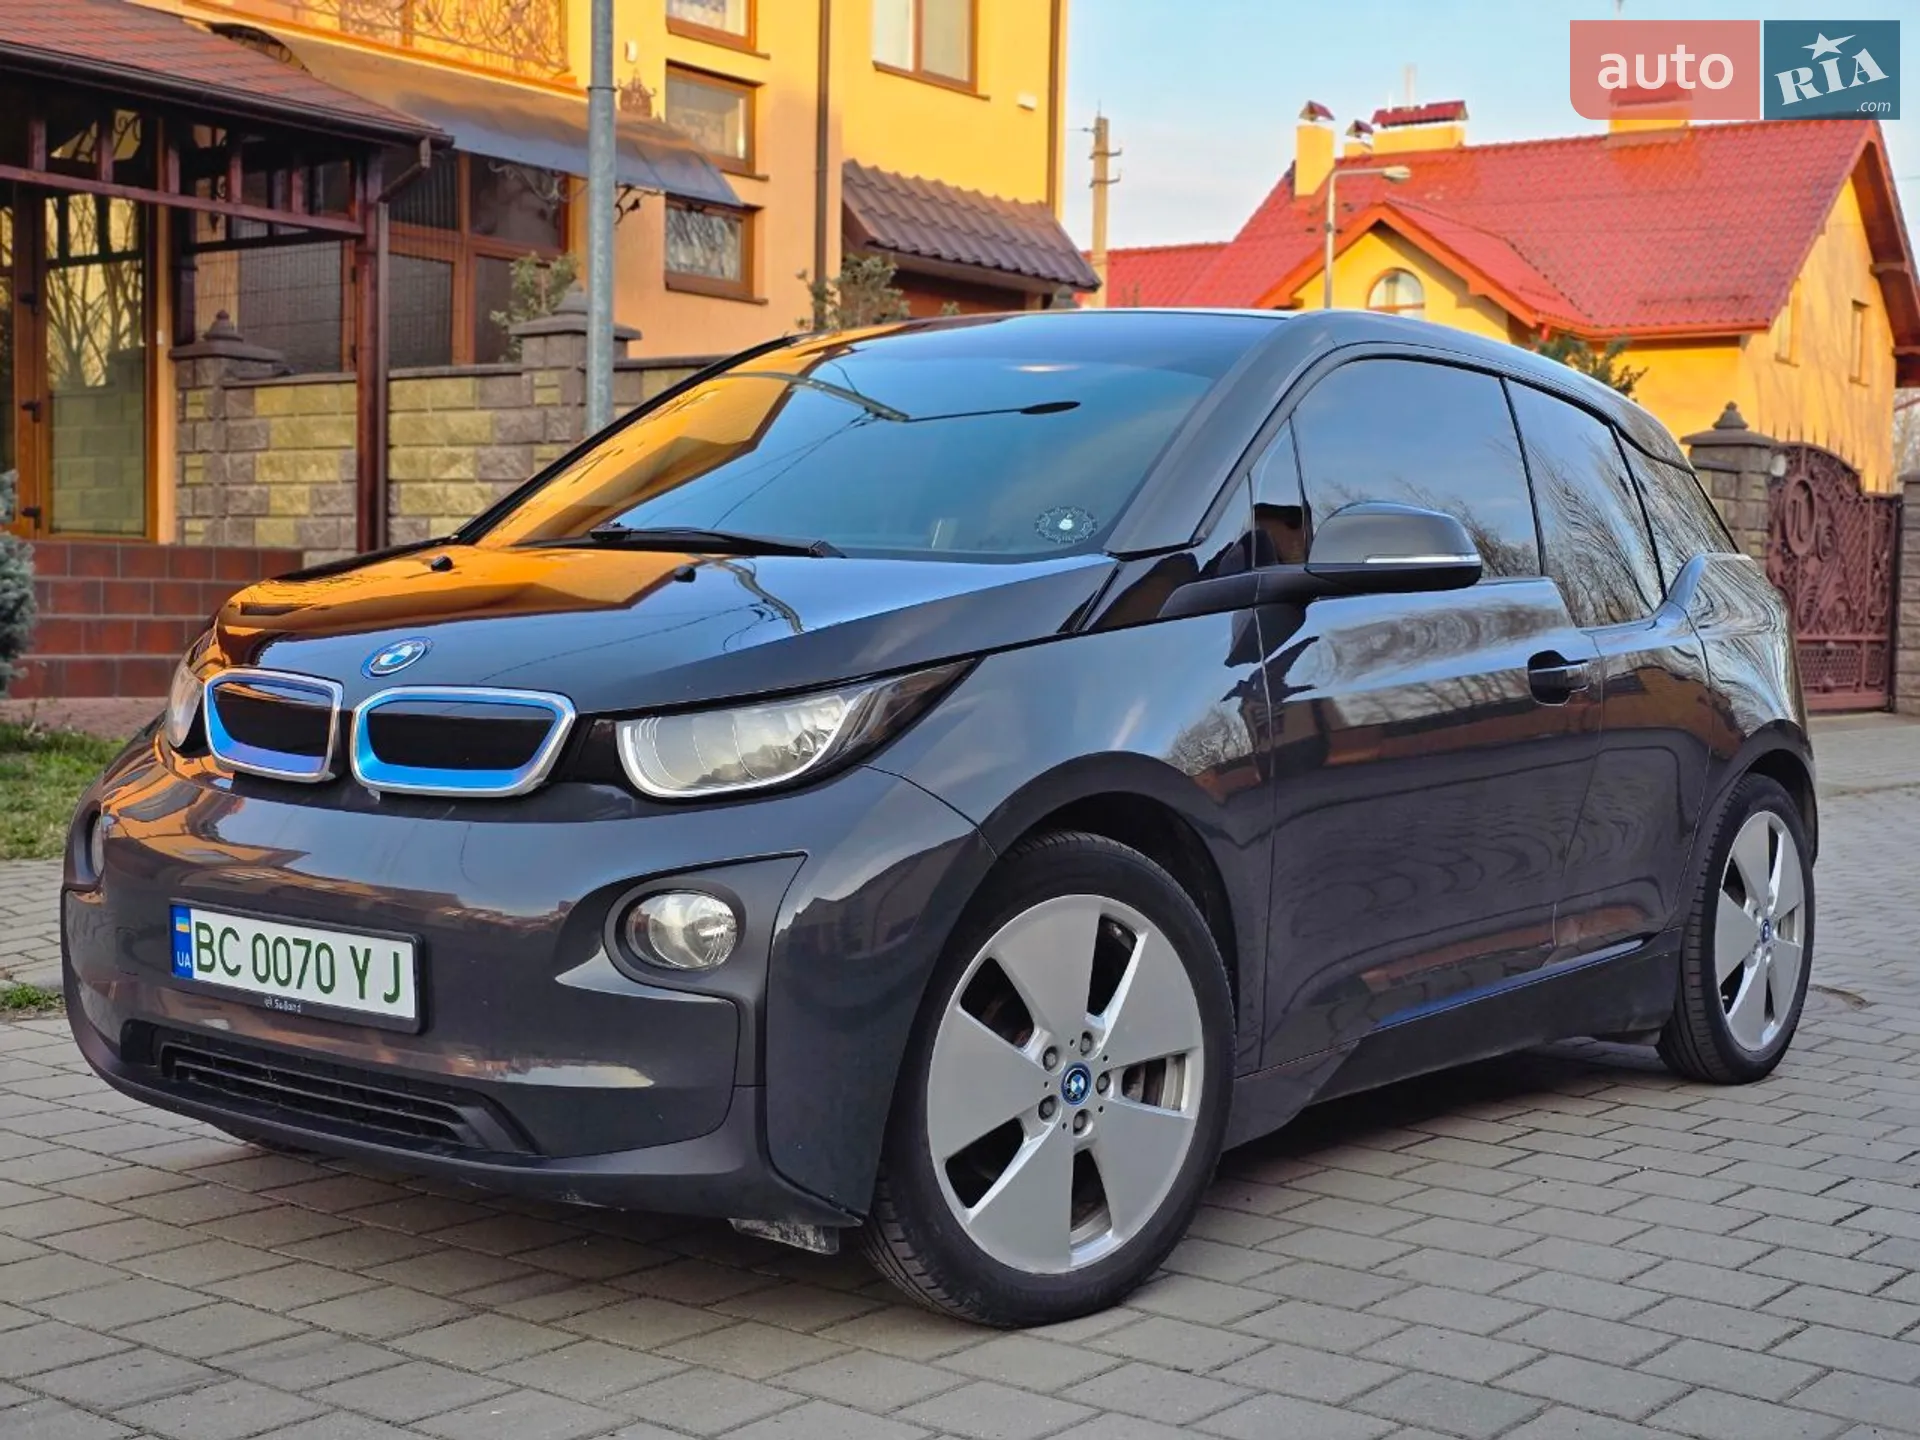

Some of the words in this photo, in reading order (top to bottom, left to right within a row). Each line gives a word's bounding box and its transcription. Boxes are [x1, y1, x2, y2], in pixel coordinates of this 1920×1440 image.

[177, 951, 191, 968] UA
[195, 921, 242, 977] BC
[252, 933, 336, 994] 0070
